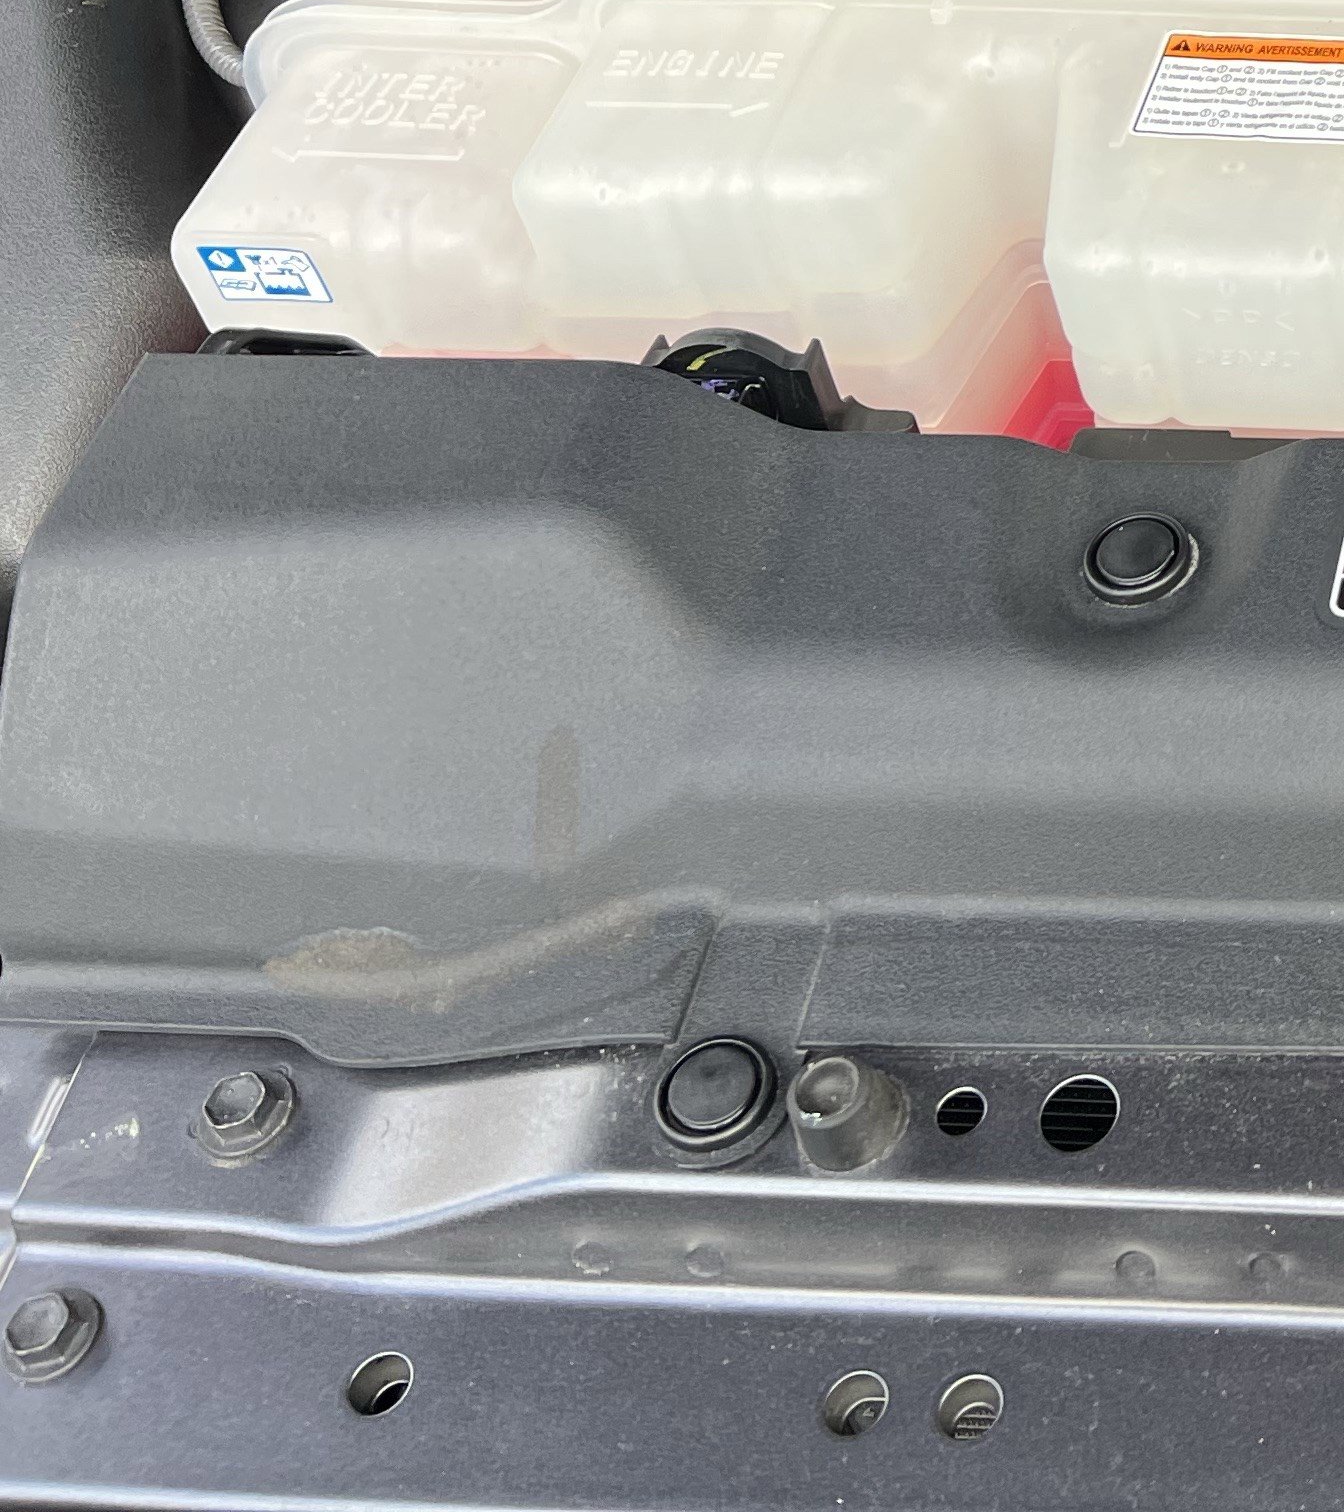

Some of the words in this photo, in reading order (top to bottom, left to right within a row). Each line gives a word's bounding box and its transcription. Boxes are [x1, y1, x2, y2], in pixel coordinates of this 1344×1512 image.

[602, 48, 785, 80] ENGINE
[1195, 41, 1254, 54] WARNING
[1258, 44, 1342, 58] AVERTISSEMENT
[312, 70, 468, 104] INTER
[302, 96, 488, 135] COOLER
